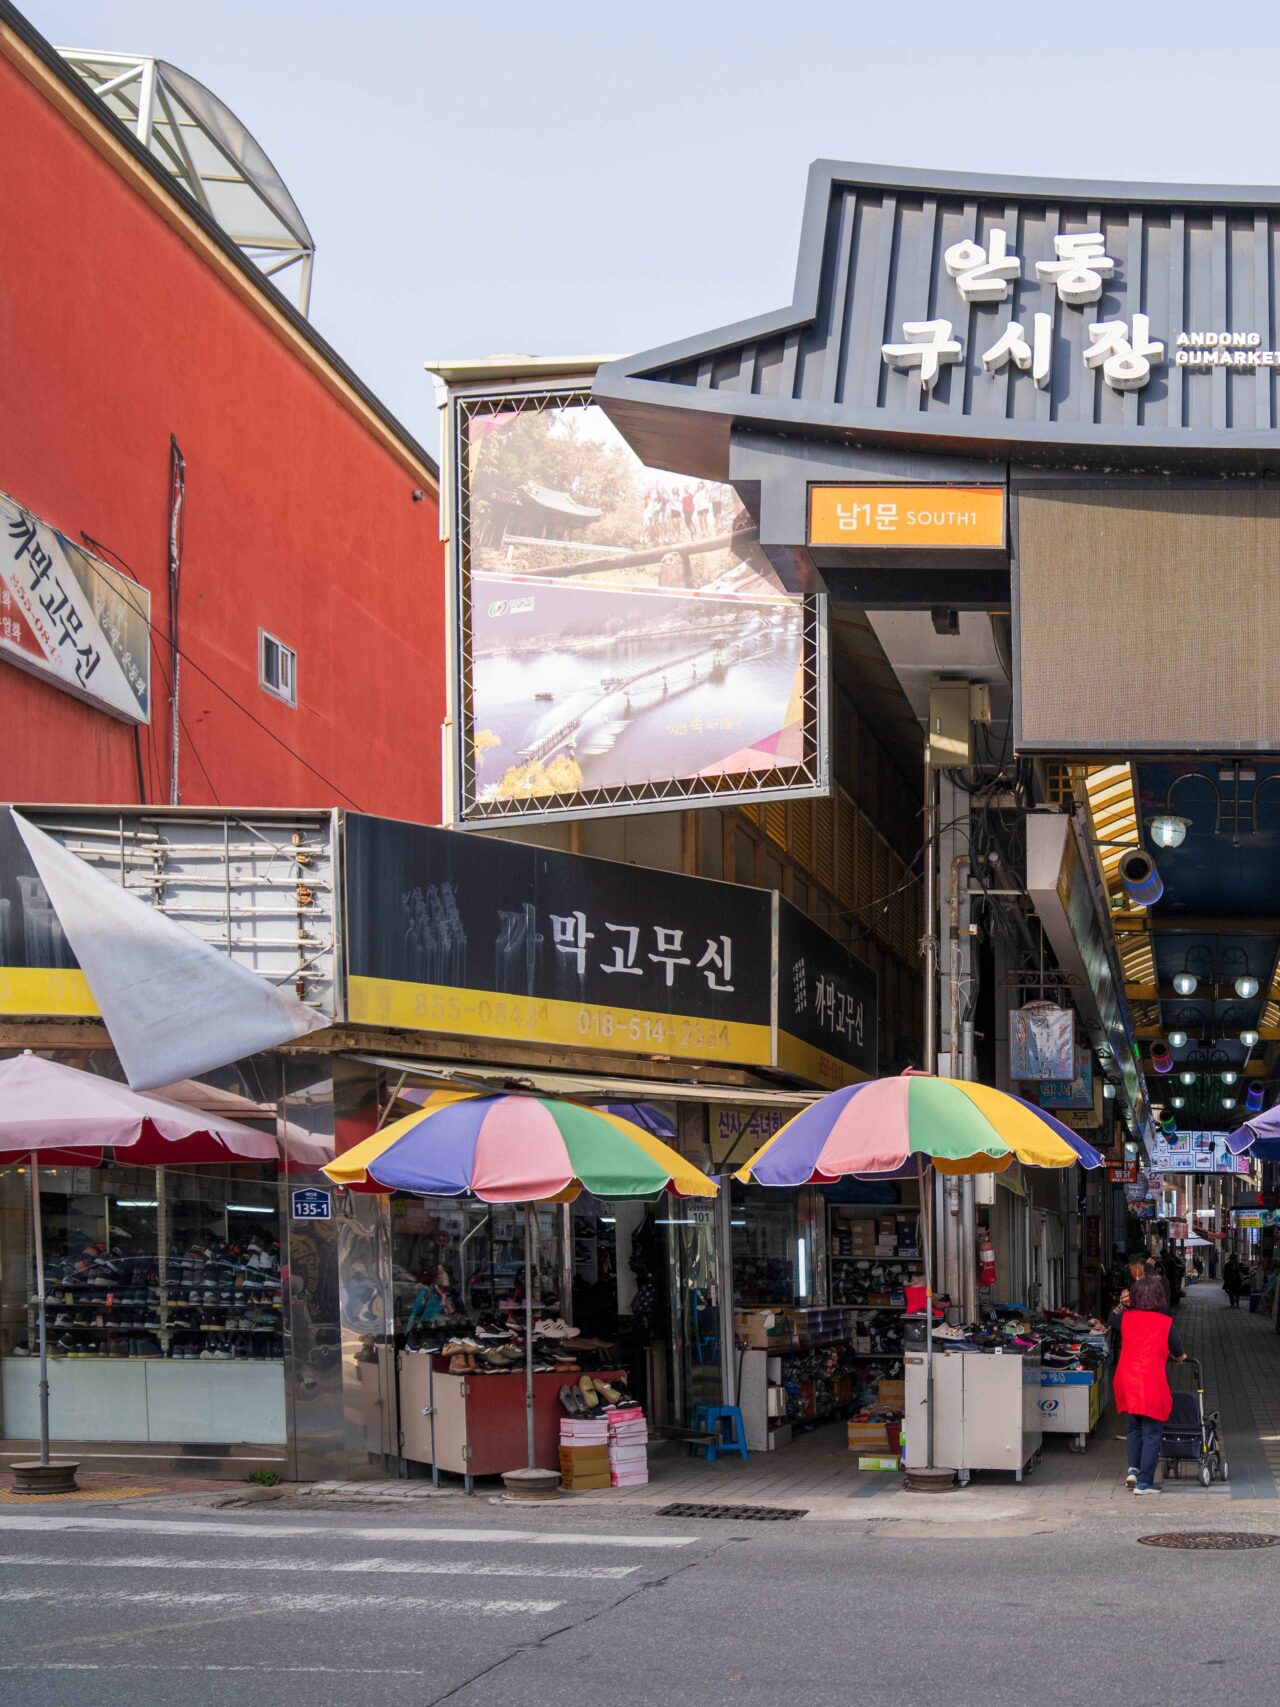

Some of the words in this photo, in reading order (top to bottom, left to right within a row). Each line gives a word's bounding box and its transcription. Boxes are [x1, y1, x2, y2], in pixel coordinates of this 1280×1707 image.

[944, 228, 1114, 304] 안동
[881, 312, 1165, 392] 구시장
[1176, 331, 1261, 347] ANDONG
[836, 503, 899, 531] 남1문
[906, 511, 977, 526] SOUTH1
[8, 511, 101, 689] 까막고무신
[815, 974, 864, 1048] 까막고무신
[295, 1203, 328, 1216] 135-1
